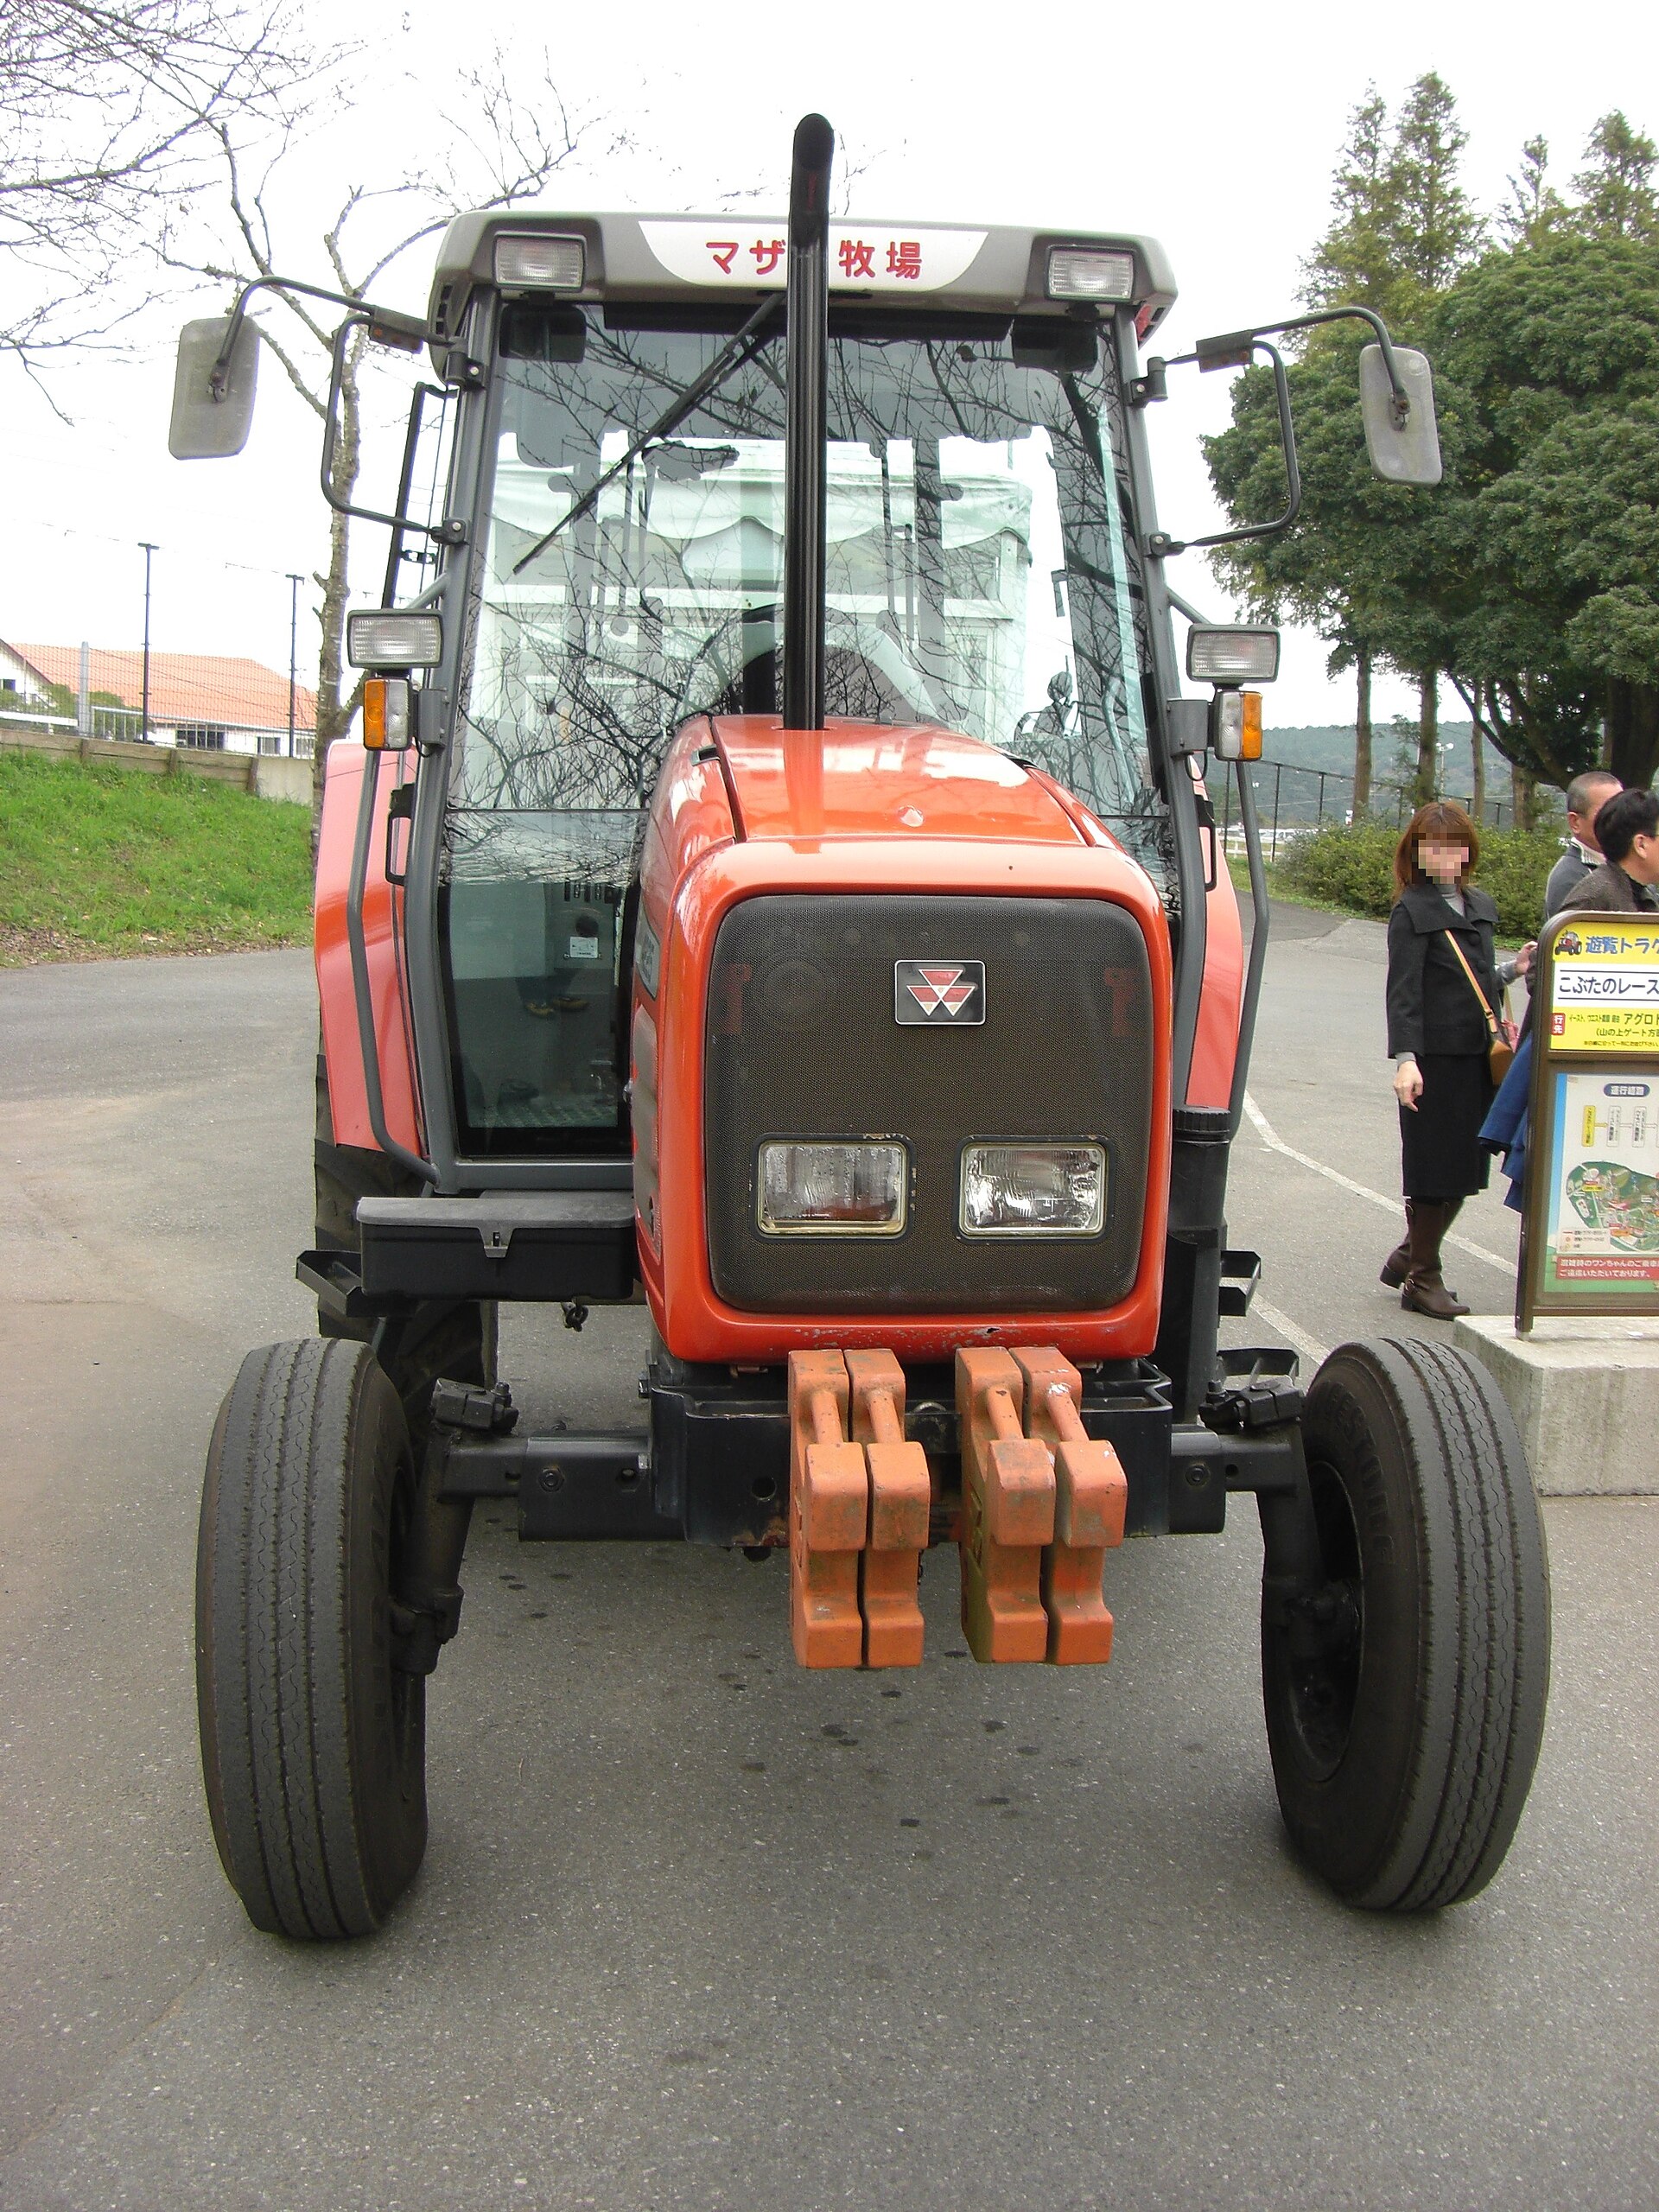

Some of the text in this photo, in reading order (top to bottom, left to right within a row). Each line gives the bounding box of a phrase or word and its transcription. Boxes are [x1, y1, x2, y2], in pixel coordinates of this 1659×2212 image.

[706, 239, 923, 280] マザ牧場
[1559, 976, 1659, 995] こぶたのレース
[1553, 1014, 1564, 1034] 行先
